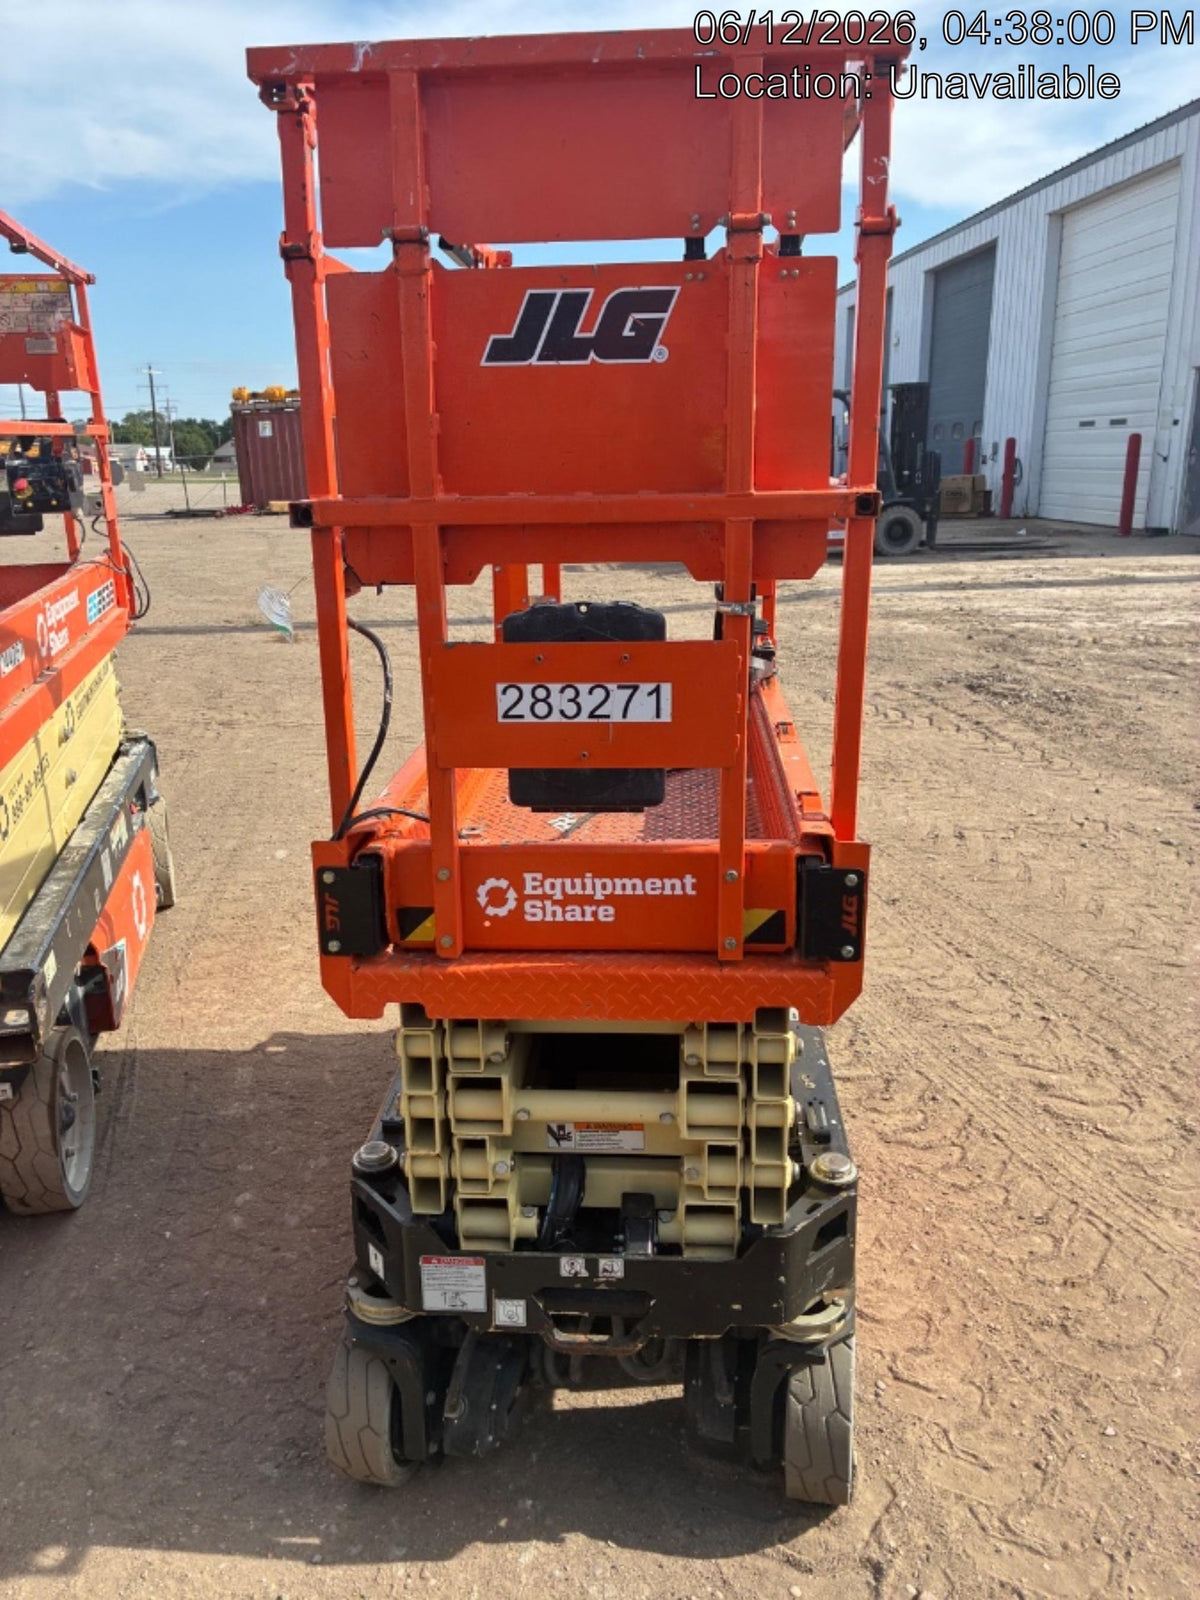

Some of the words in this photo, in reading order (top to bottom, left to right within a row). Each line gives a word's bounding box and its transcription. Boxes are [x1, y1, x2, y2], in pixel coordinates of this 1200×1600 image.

[501, 683, 662, 720] 283271
[523, 872, 697, 900] Equipment
[523, 900, 616, 922] Share
